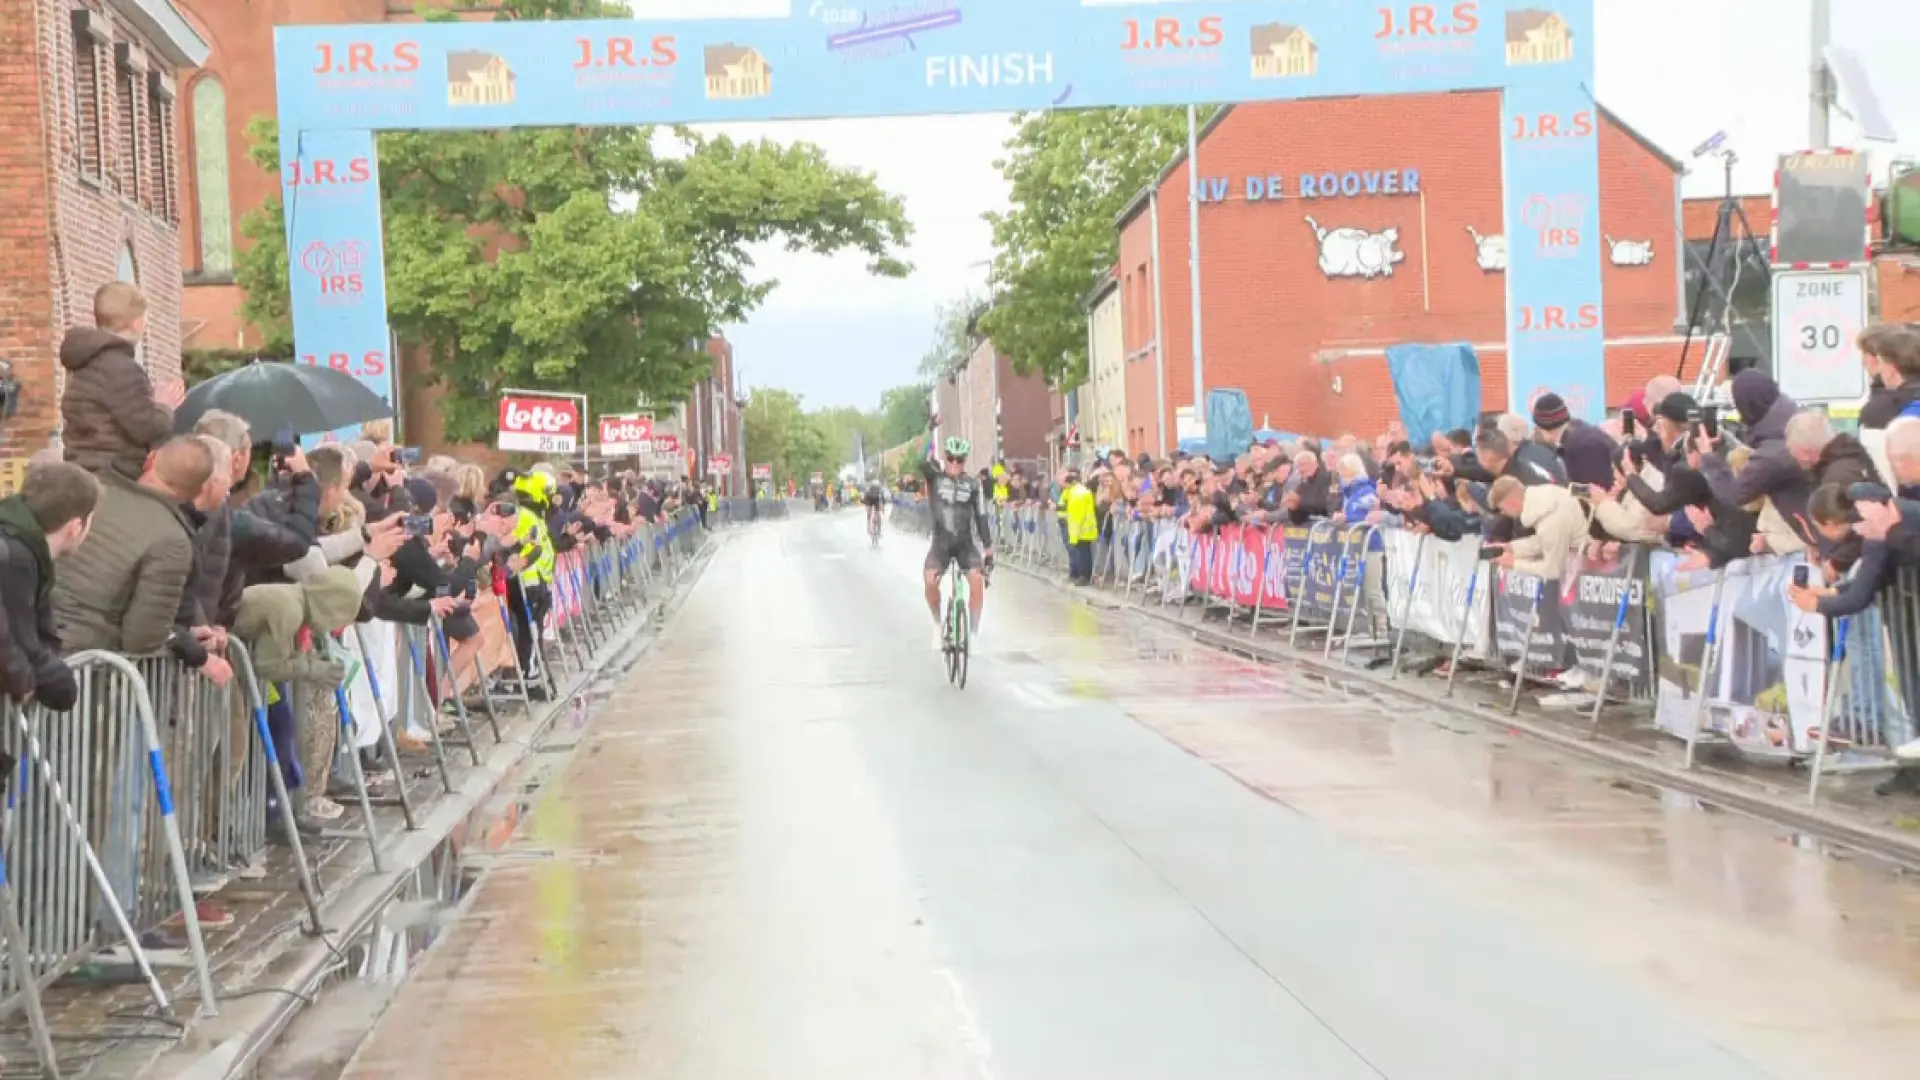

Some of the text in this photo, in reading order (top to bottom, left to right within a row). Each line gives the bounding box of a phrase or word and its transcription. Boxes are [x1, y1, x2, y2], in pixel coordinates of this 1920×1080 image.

[1121, 16, 1224, 50] J.R.S
[1374, 2, 1479, 38] J.R.S
[313, 42, 420, 75] J.R.S
[573, 36, 677, 69] J.R.S
[925, 51, 1053, 88] FINISH
[1511, 111, 1592, 140] J.R.S
[286, 158, 370, 186] J.R.S
[1246, 176, 1282, 200] DE
[1301, 168, 1420, 197] ROOVER
[321, 275, 363, 294] IRS
[1796, 280, 1844, 297] ZONE
[1516, 304, 1598, 331] J.R.S
[1800, 325, 1840, 349] 30
[301, 352, 385, 378] R.S
[539, 435, 570, 452] 25 m
